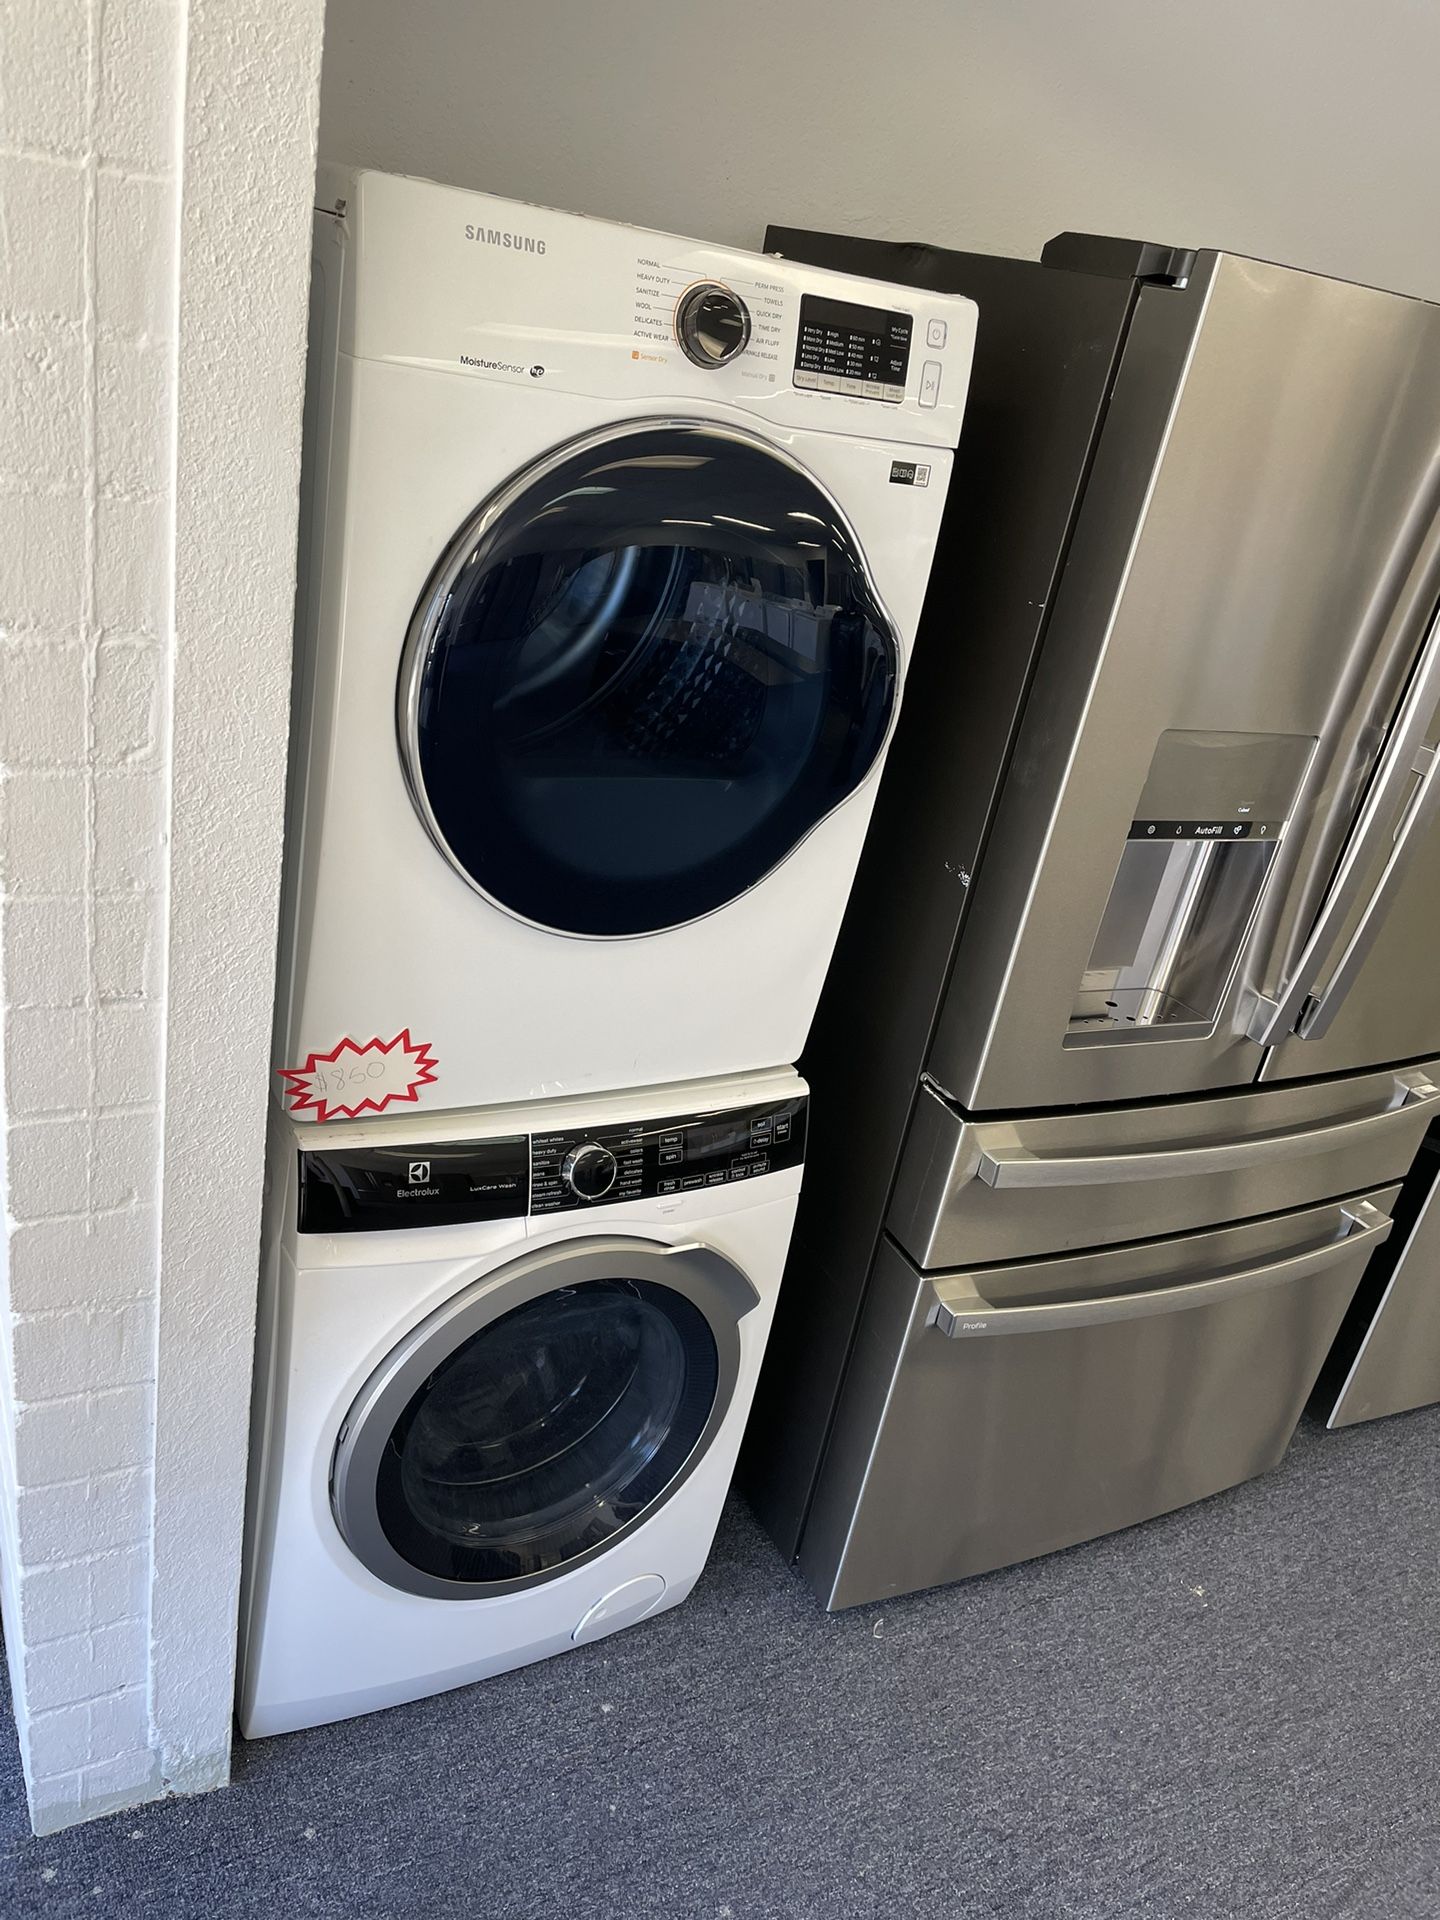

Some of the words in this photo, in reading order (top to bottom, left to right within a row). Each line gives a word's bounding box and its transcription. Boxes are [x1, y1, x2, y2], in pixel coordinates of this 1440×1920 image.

[465, 224, 546, 255] SAMSUNG
[637, 258, 661, 268] NORMAL
[636, 272, 654, 281] HEAVY
[636, 286, 660, 298] SANITIZE
[770, 284, 784, 292] PRESS
[635, 302, 652, 310] WOOL
[764, 297, 784, 306] TOWELS
[634, 316, 662, 326] DELICATES
[633, 330, 652, 339] ACTIVE
[653, 334, 669, 342] WEAR
[658, 356, 668, 364] Dry
[761, 352, 778, 360] RELEASE
[460, 355, 524, 374] MoistureSensor
[1194, 826, 1223, 835] AutoFill
[397, 1188, 440, 1198] Electrolux
[963, 1322, 987, 1330] Profile
